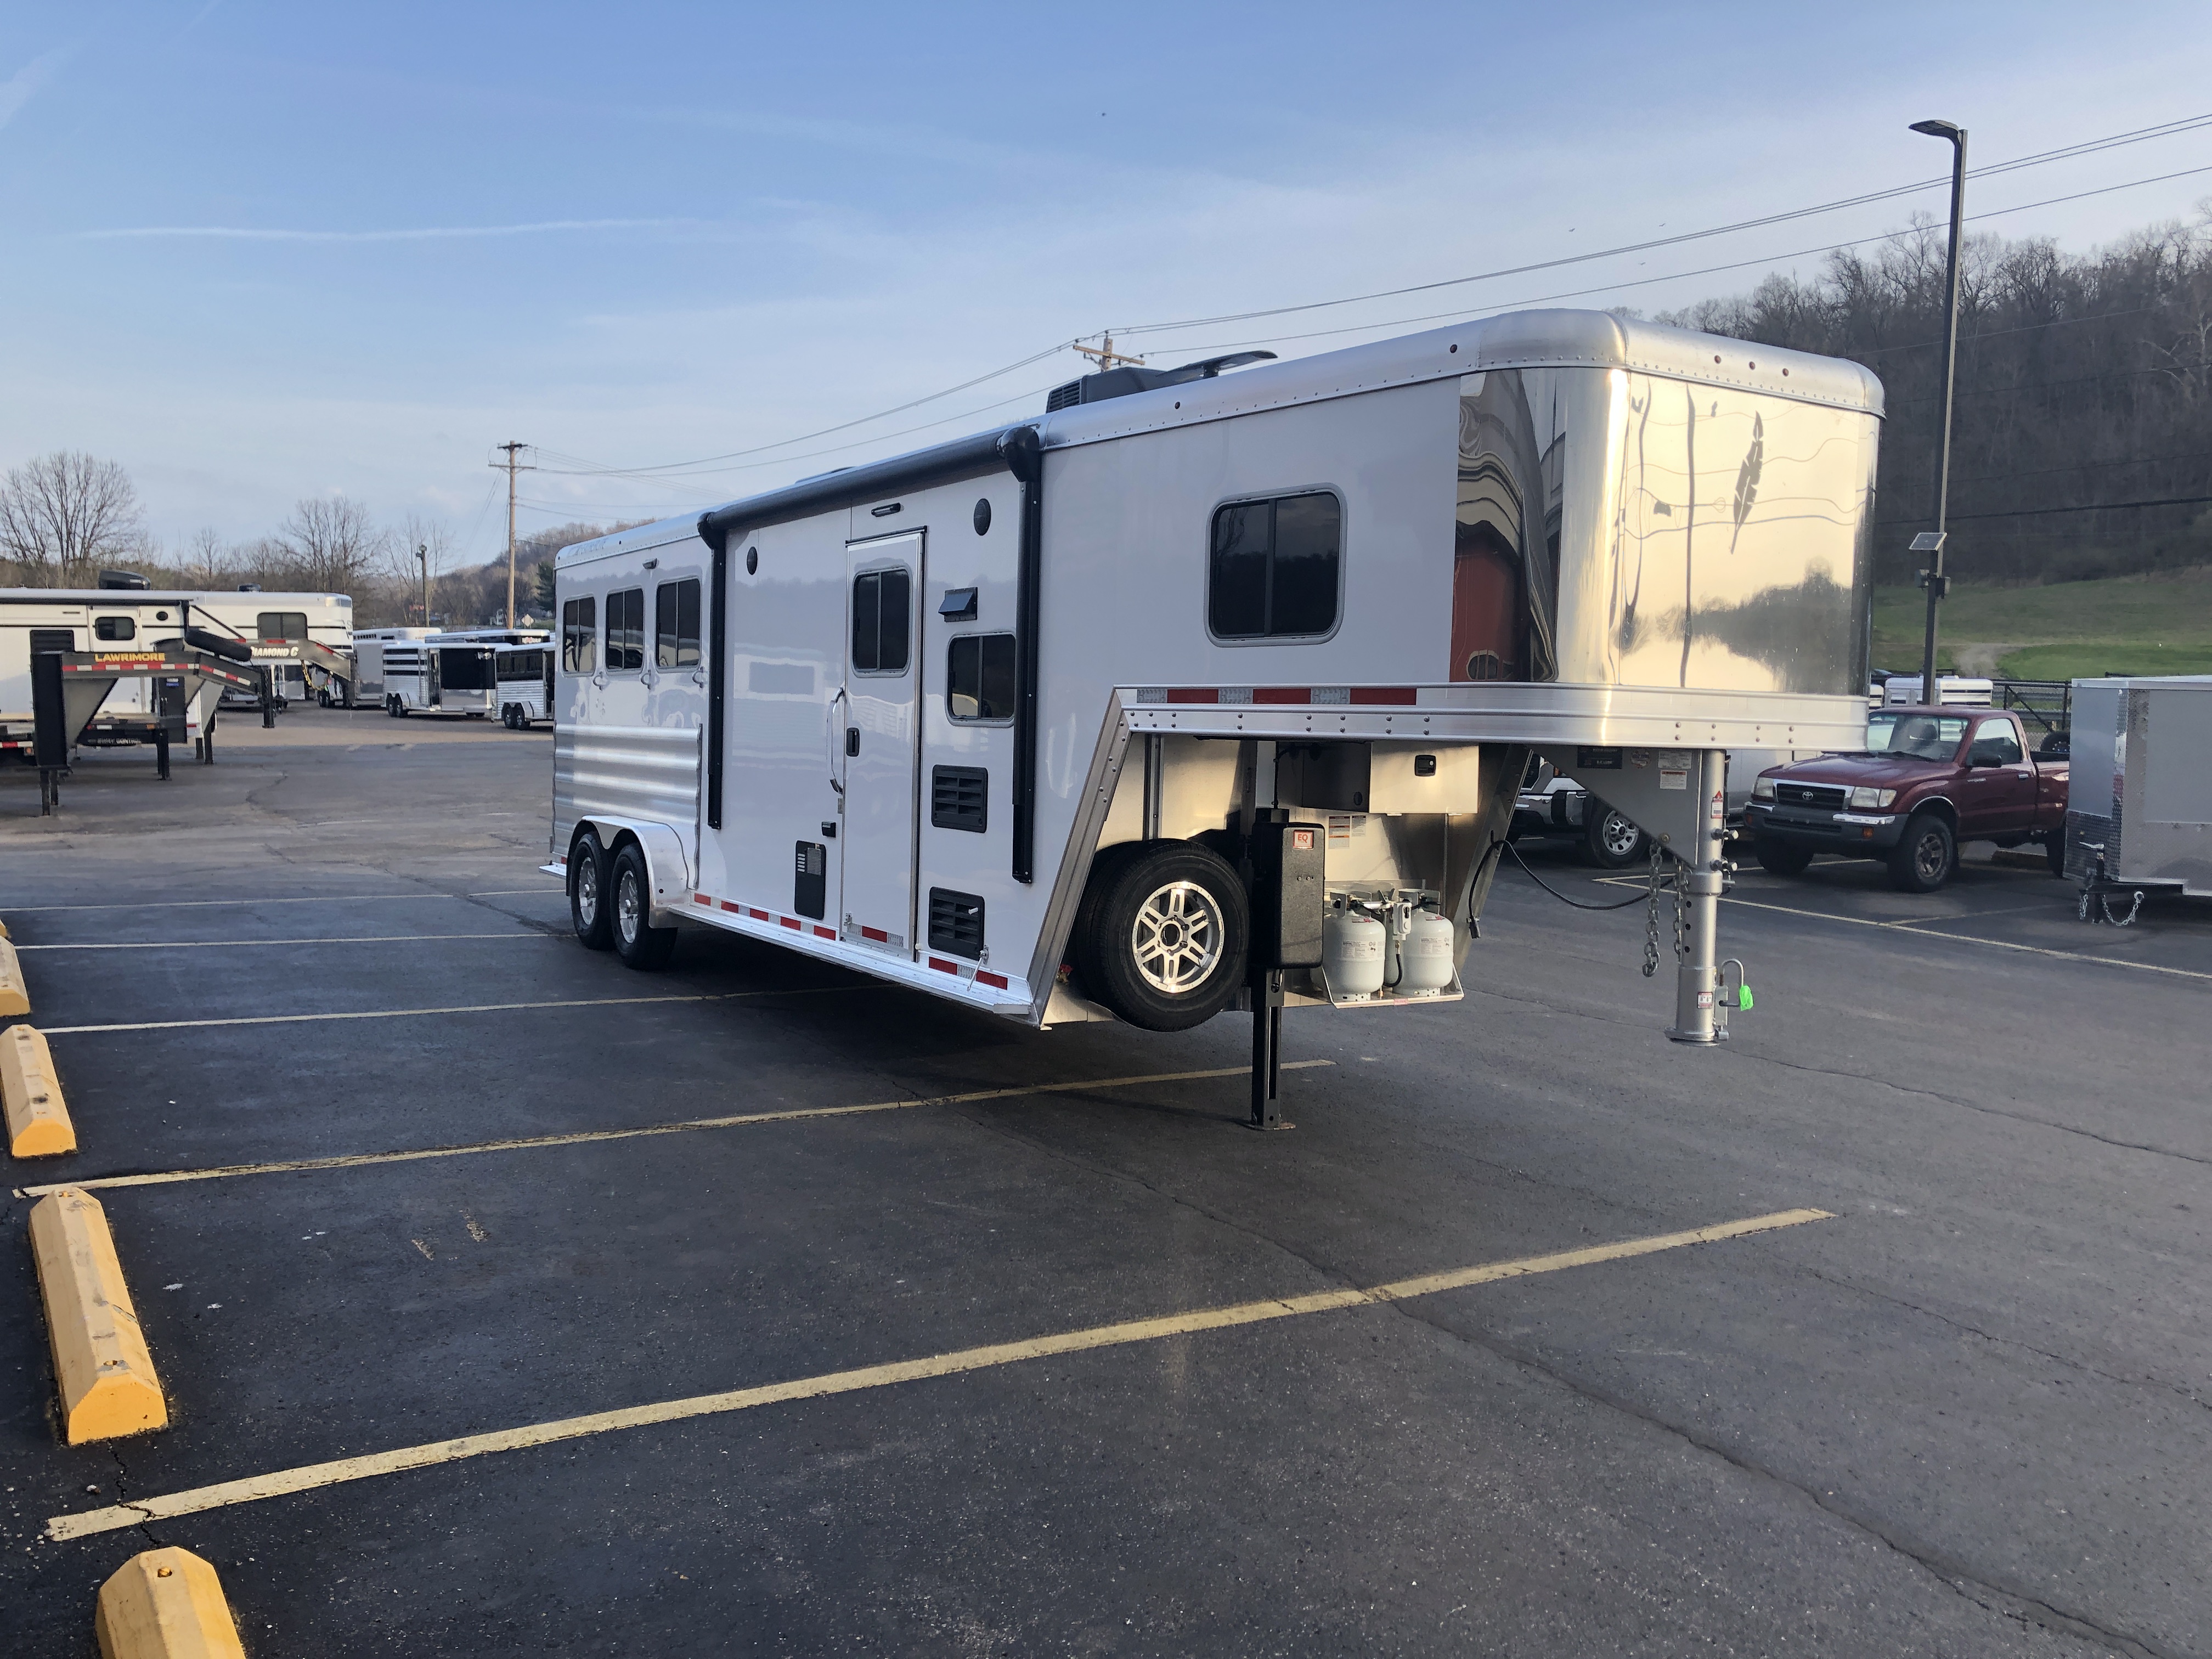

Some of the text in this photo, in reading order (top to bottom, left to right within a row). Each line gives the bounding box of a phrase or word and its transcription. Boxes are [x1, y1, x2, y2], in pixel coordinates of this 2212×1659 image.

[290, 646, 299, 657] C
[94, 652, 165, 662] LAWRIMORE
[1297, 833, 1308, 843] EQ
